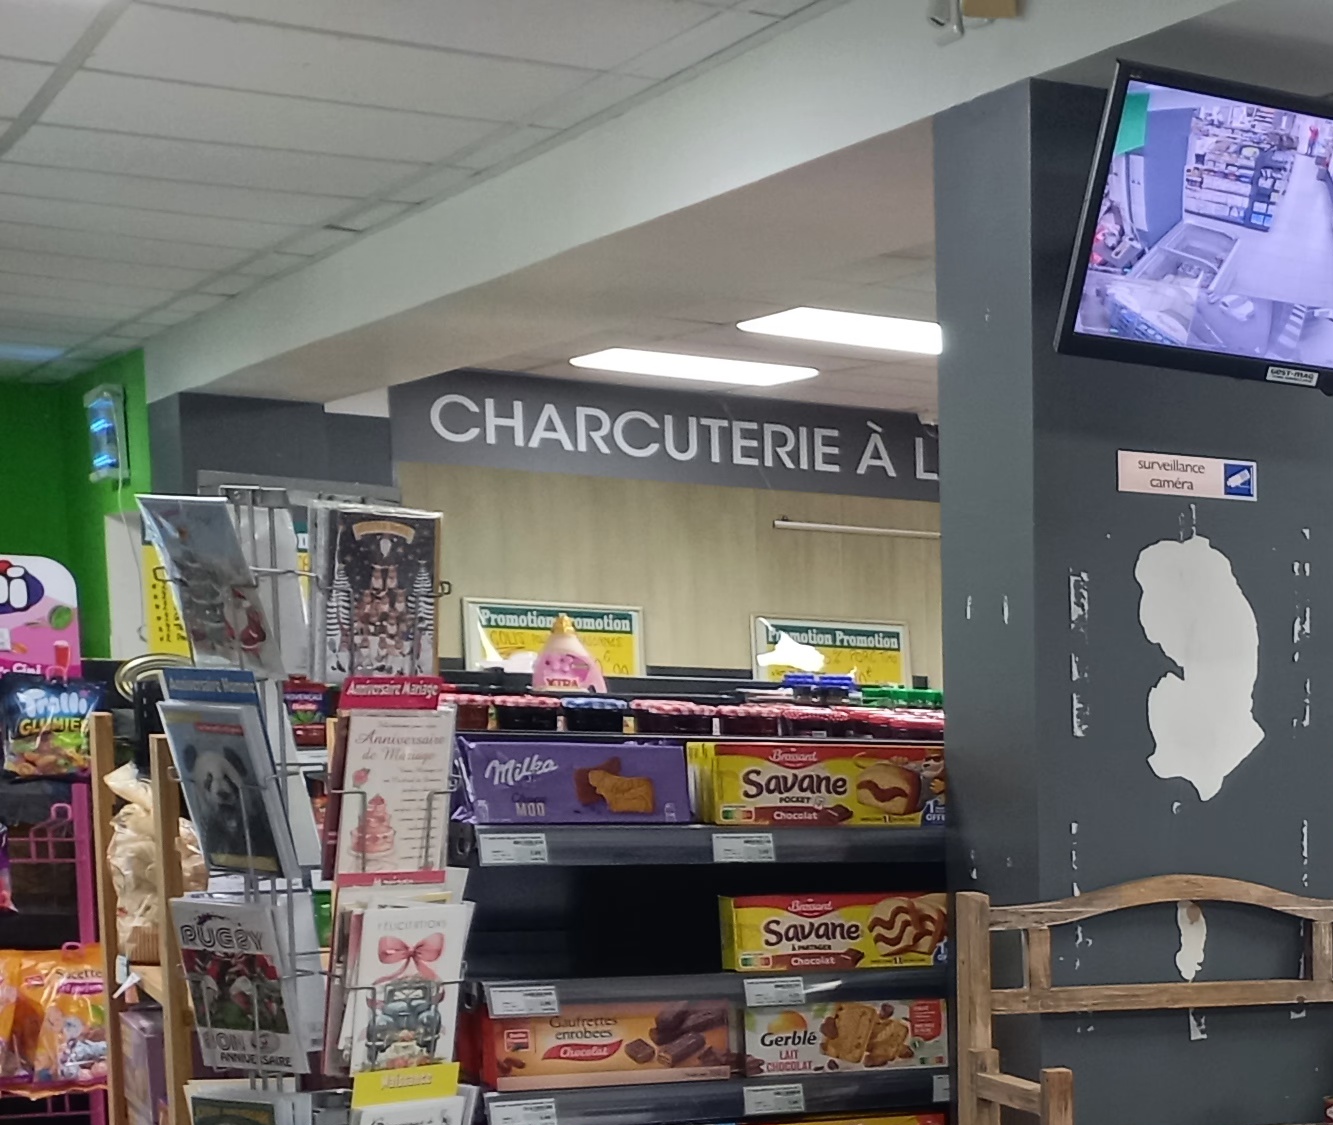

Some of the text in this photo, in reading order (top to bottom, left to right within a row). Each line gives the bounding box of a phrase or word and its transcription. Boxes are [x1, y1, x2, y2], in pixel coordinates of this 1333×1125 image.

[429, 393, 940, 481] CHARCUTERIE À L
[1137, 457, 1206, 476] surveillance
[1149, 477, 1194, 492] caméra
[480, 607, 553, 630] Promotion
[834, 630, 898, 650] Promotion
[346, 680, 439, 698] Anniversaire Mariage
[17, 688, 88, 718] Trolli
[355, 731, 445, 745] Anniversaire
[484, 755, 558, 787] Milka
[742, 769, 848, 799] Savane
[773, 809, 818, 821] Chocolat
[180, 924, 264, 951] RUGBY
[763, 918, 861, 948] Savane
[790, 955, 836, 967] Chocolat
[54, 966, 103, 982] Sucette
[555, 1026, 613, 1041] enrobées
[760, 1031, 817, 1050] Gerblé
[558, 1043, 609, 1059] Chocolat
[779, 1049, 800, 1062] LAIT
[766, 1060, 813, 1073] CHOCOLAT
